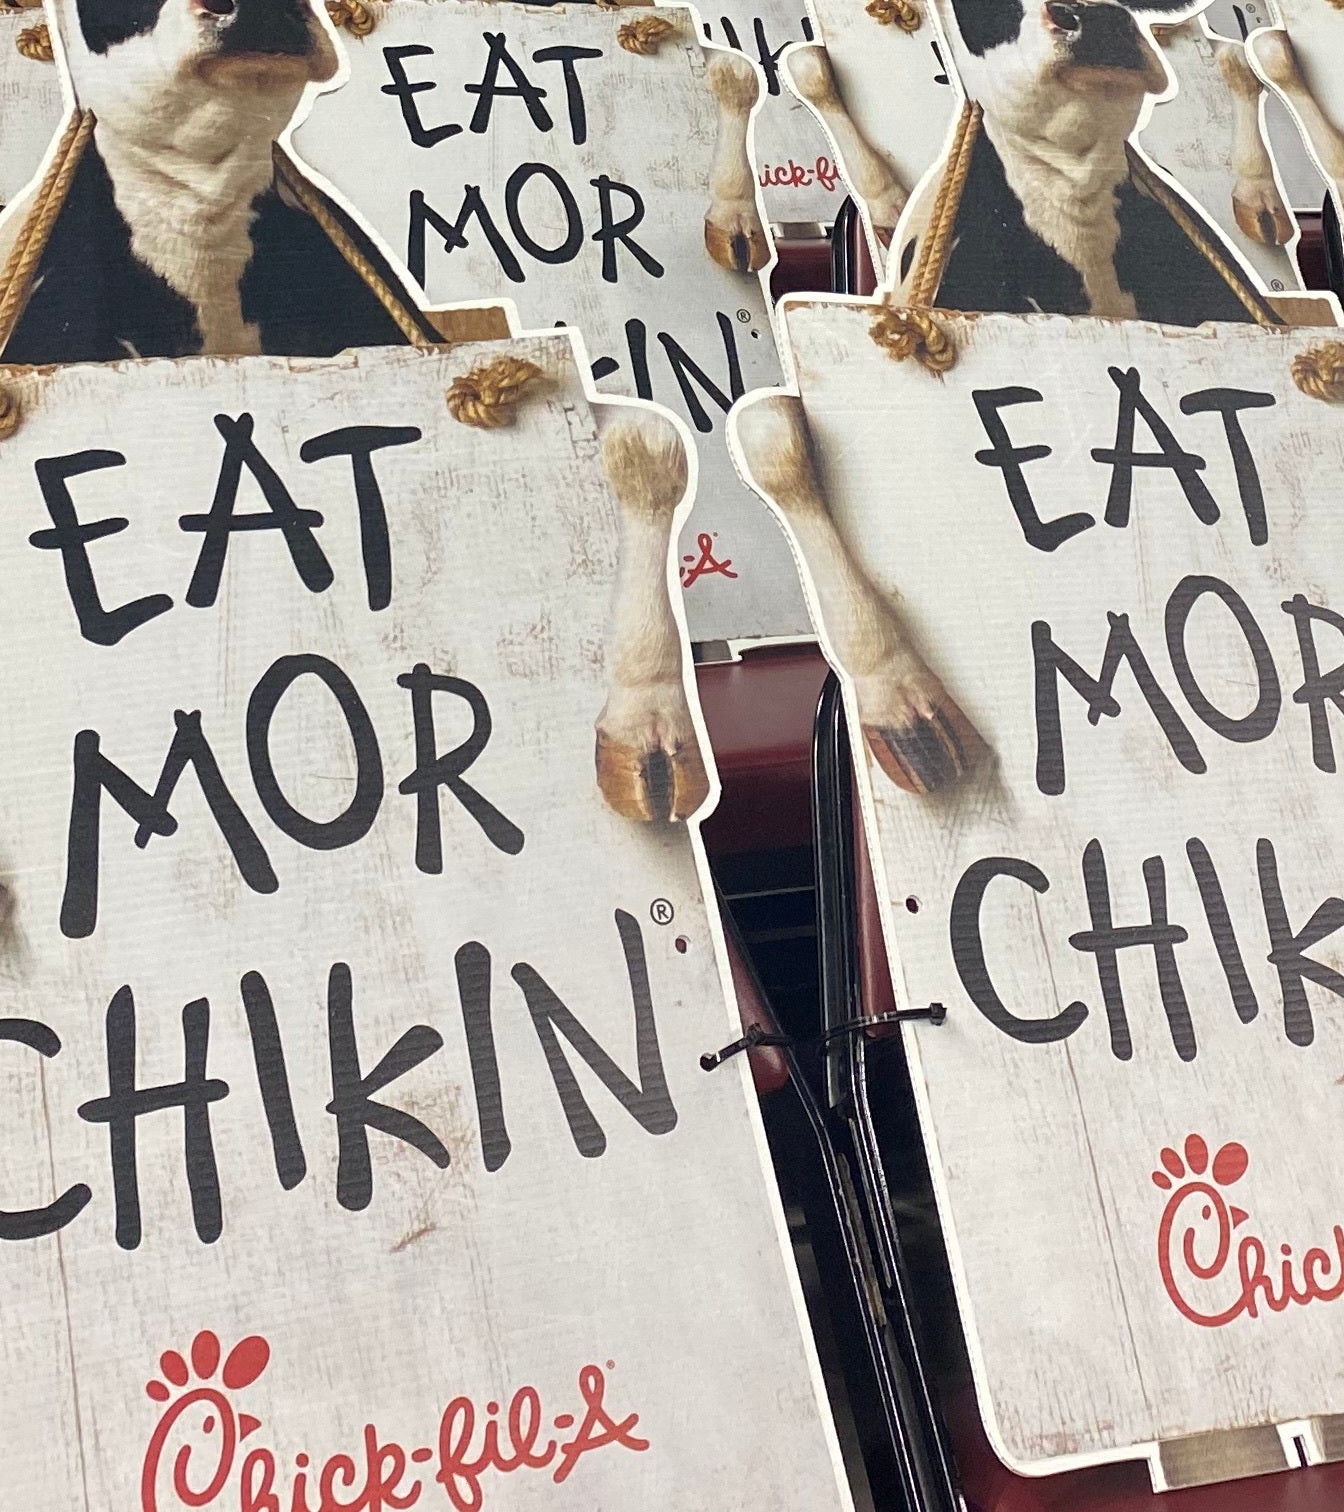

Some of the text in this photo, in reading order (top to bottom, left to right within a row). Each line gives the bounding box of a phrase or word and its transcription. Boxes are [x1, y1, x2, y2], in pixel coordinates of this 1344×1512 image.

[381, 31, 603, 148] EAT
[407, 162, 665, 283] MOR
[28, 411, 423, 647] EAT
[971, 365, 1277, 553] EAT
[59, 653, 526, 941] MOR
